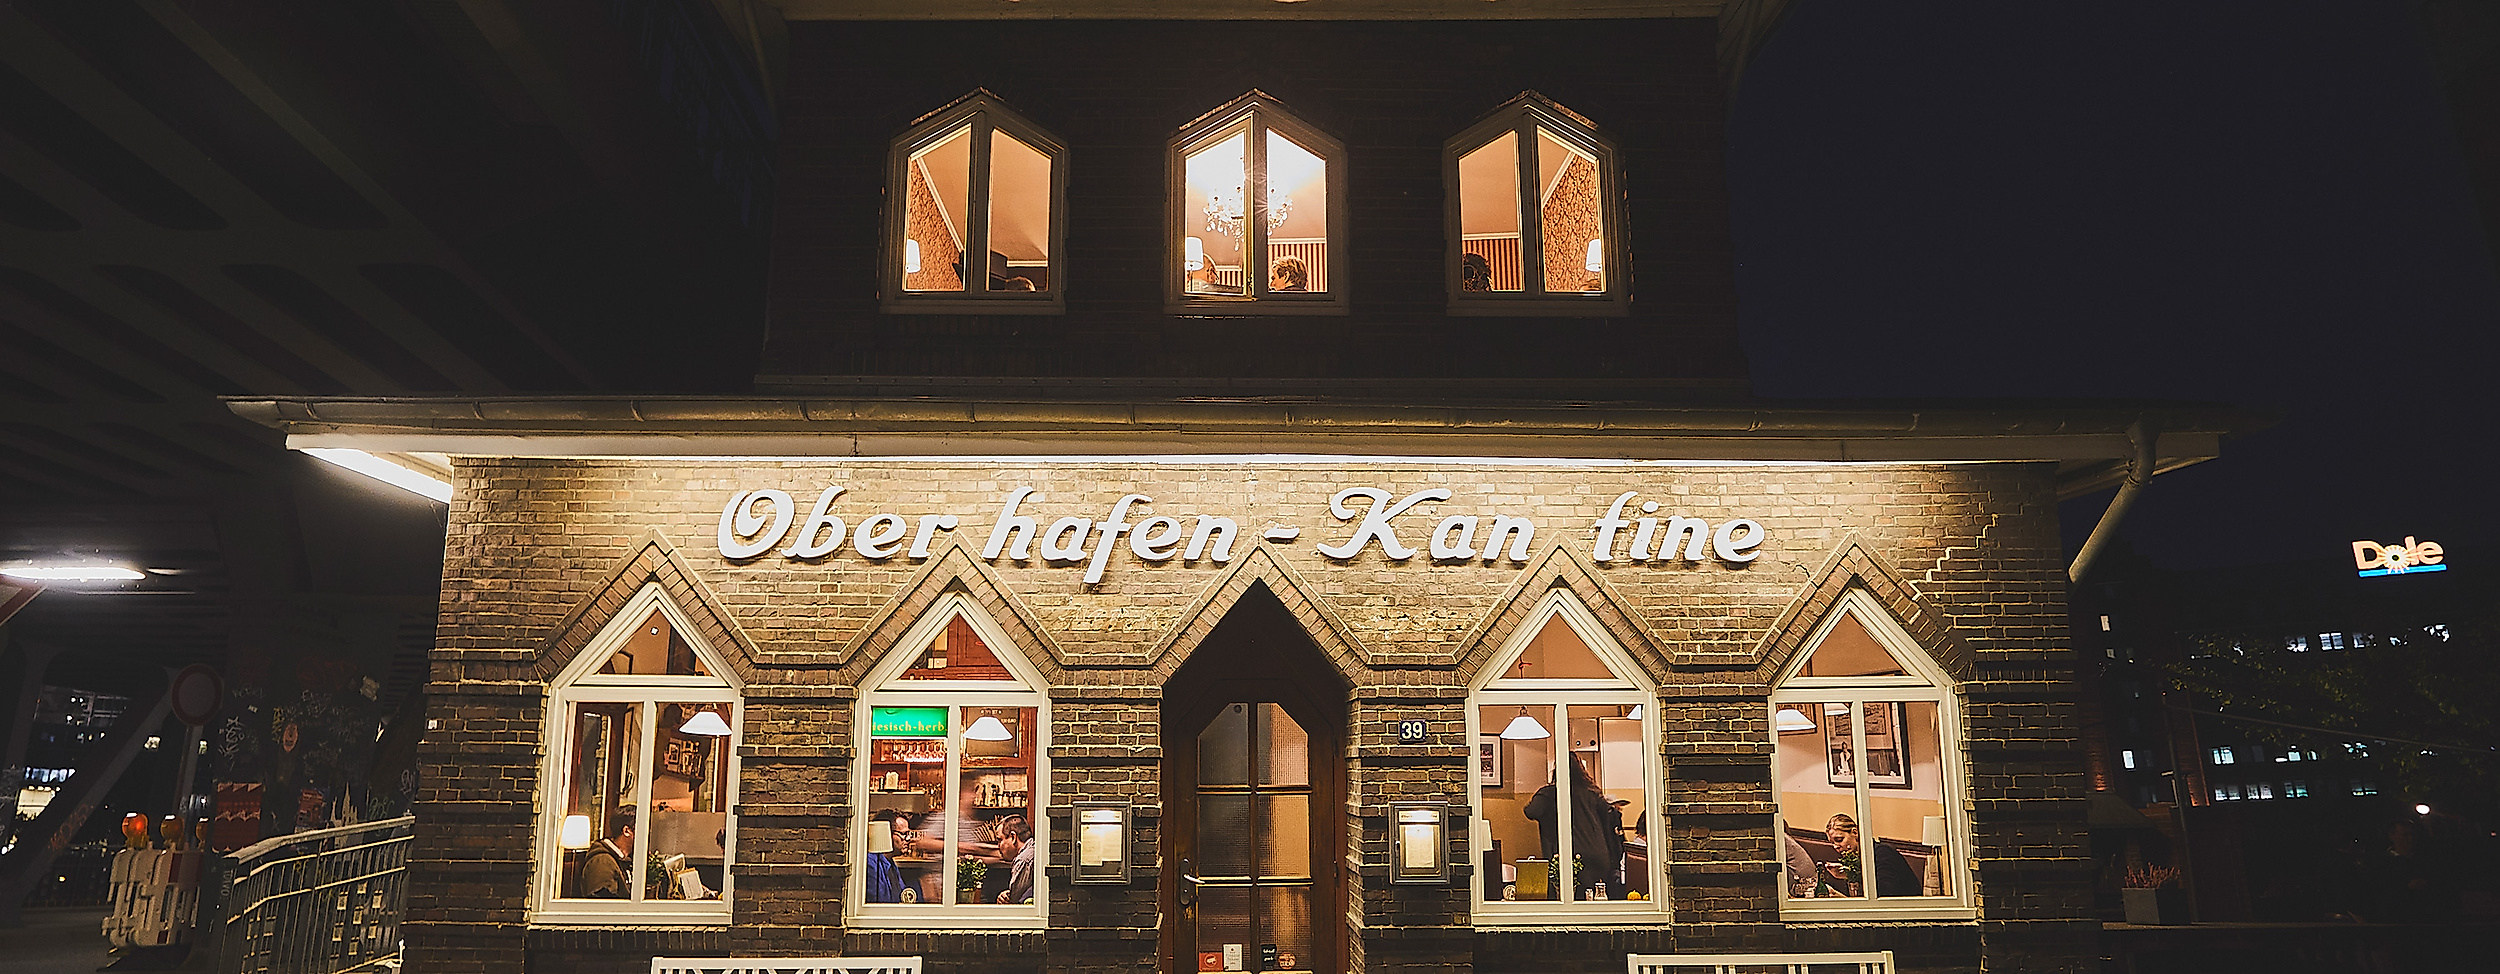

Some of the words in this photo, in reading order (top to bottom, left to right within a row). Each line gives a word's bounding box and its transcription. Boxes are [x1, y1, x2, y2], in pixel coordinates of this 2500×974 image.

[717, 486, 959, 560] Ober
[981, 481, 1238, 584] hafen
[1316, 486, 1535, 561] Kan
[2352, 535, 2445, 570] Dole
[1401, 721, 1423, 740] 39
